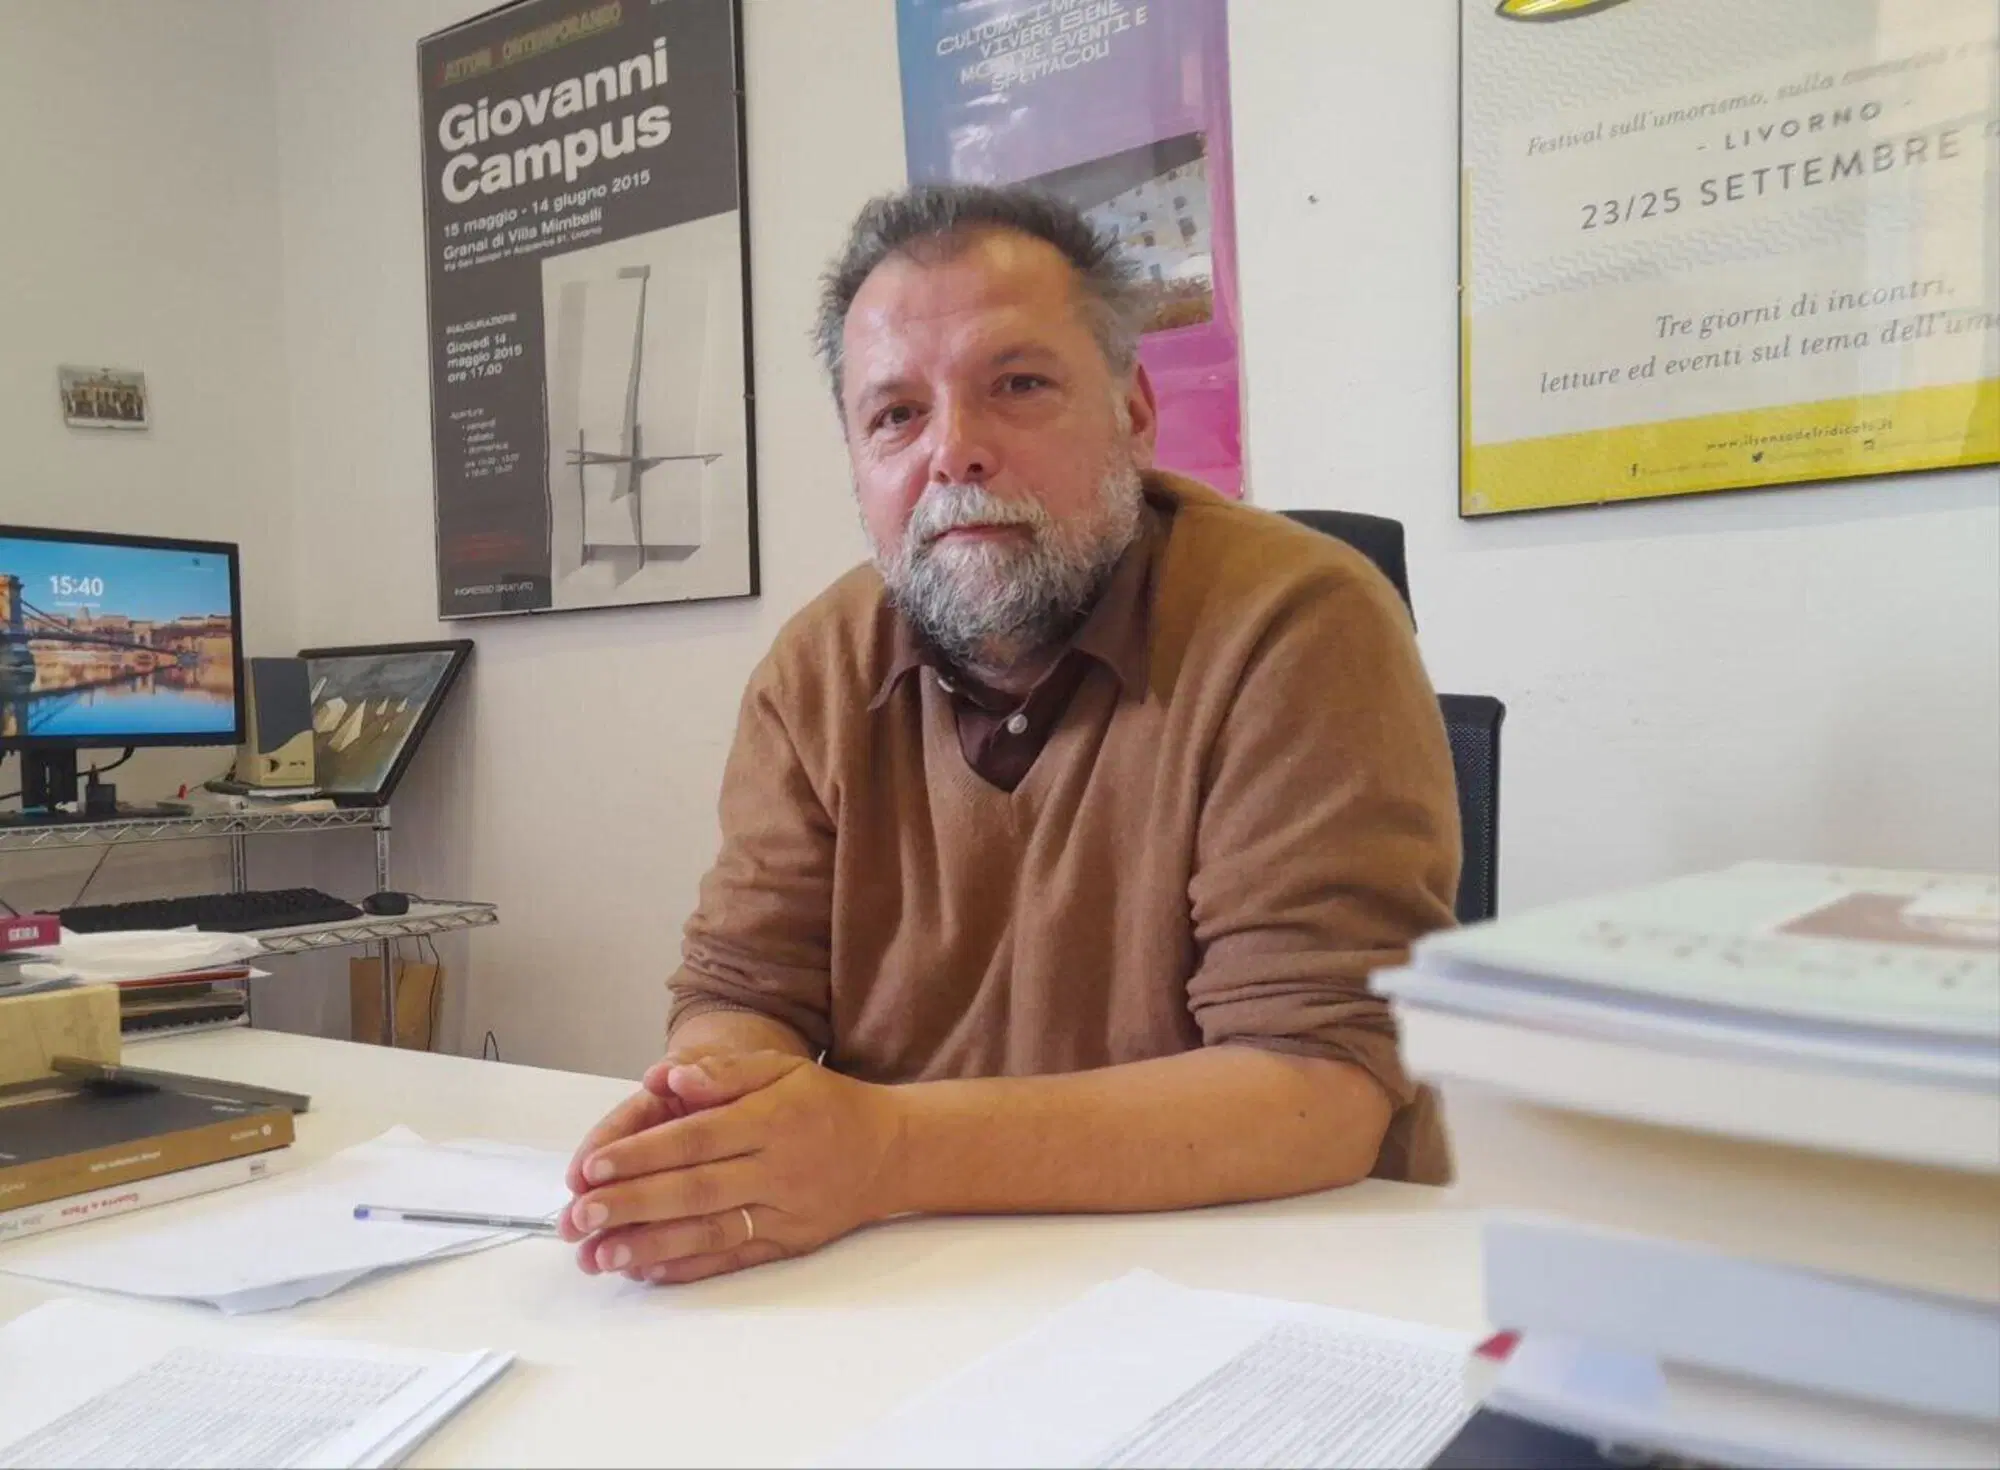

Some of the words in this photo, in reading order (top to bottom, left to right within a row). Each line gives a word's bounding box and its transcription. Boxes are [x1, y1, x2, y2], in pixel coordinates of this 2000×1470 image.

[980, 19, 1052, 59] VIVERE
[1060, 0, 1124, 32] BENE
[1051, 12, 1131, 53] EVENTI
[1136, 5, 1149, 27] E
[438, 36, 668, 152] Giovanni
[1526, 121, 1603, 157] Festival
[1725, 101, 1882, 151] LIVORNO
[441, 105, 672, 204] Campus
[1581, 186, 1681, 230] 23/25
[1699, 129, 1961, 207] SETTEMBRE
[444, 222, 460, 239] 15
[463, 208, 518, 234] maggio
[532, 199, 549, 216] 14
[553, 184, 607, 213] giugno
[611, 169, 650, 193] 2015
[443, 237, 488, 261] Granai
[492, 234, 504, 249] di
[508, 226, 538, 243] Villa
[541, 207, 602, 235] Mimbelli
[494, 333, 507, 346] 14
[1656, 313, 1693, 339] Tre
[1698, 298, 1782, 341] giorni
[1790, 292, 1820, 318] di
[447, 351, 491, 369] maggio
[447, 371, 467, 383] ore
[1540, 367, 1620, 394] letture
[1627, 355, 1657, 381] ed
[1665, 345, 1743, 375] eventi
[1751, 334, 1792, 364] sul
[1801, 331, 1870, 356] tema
[1880, 311, 2000, 345] dell'um
[50, 575, 104, 596] 15:40
